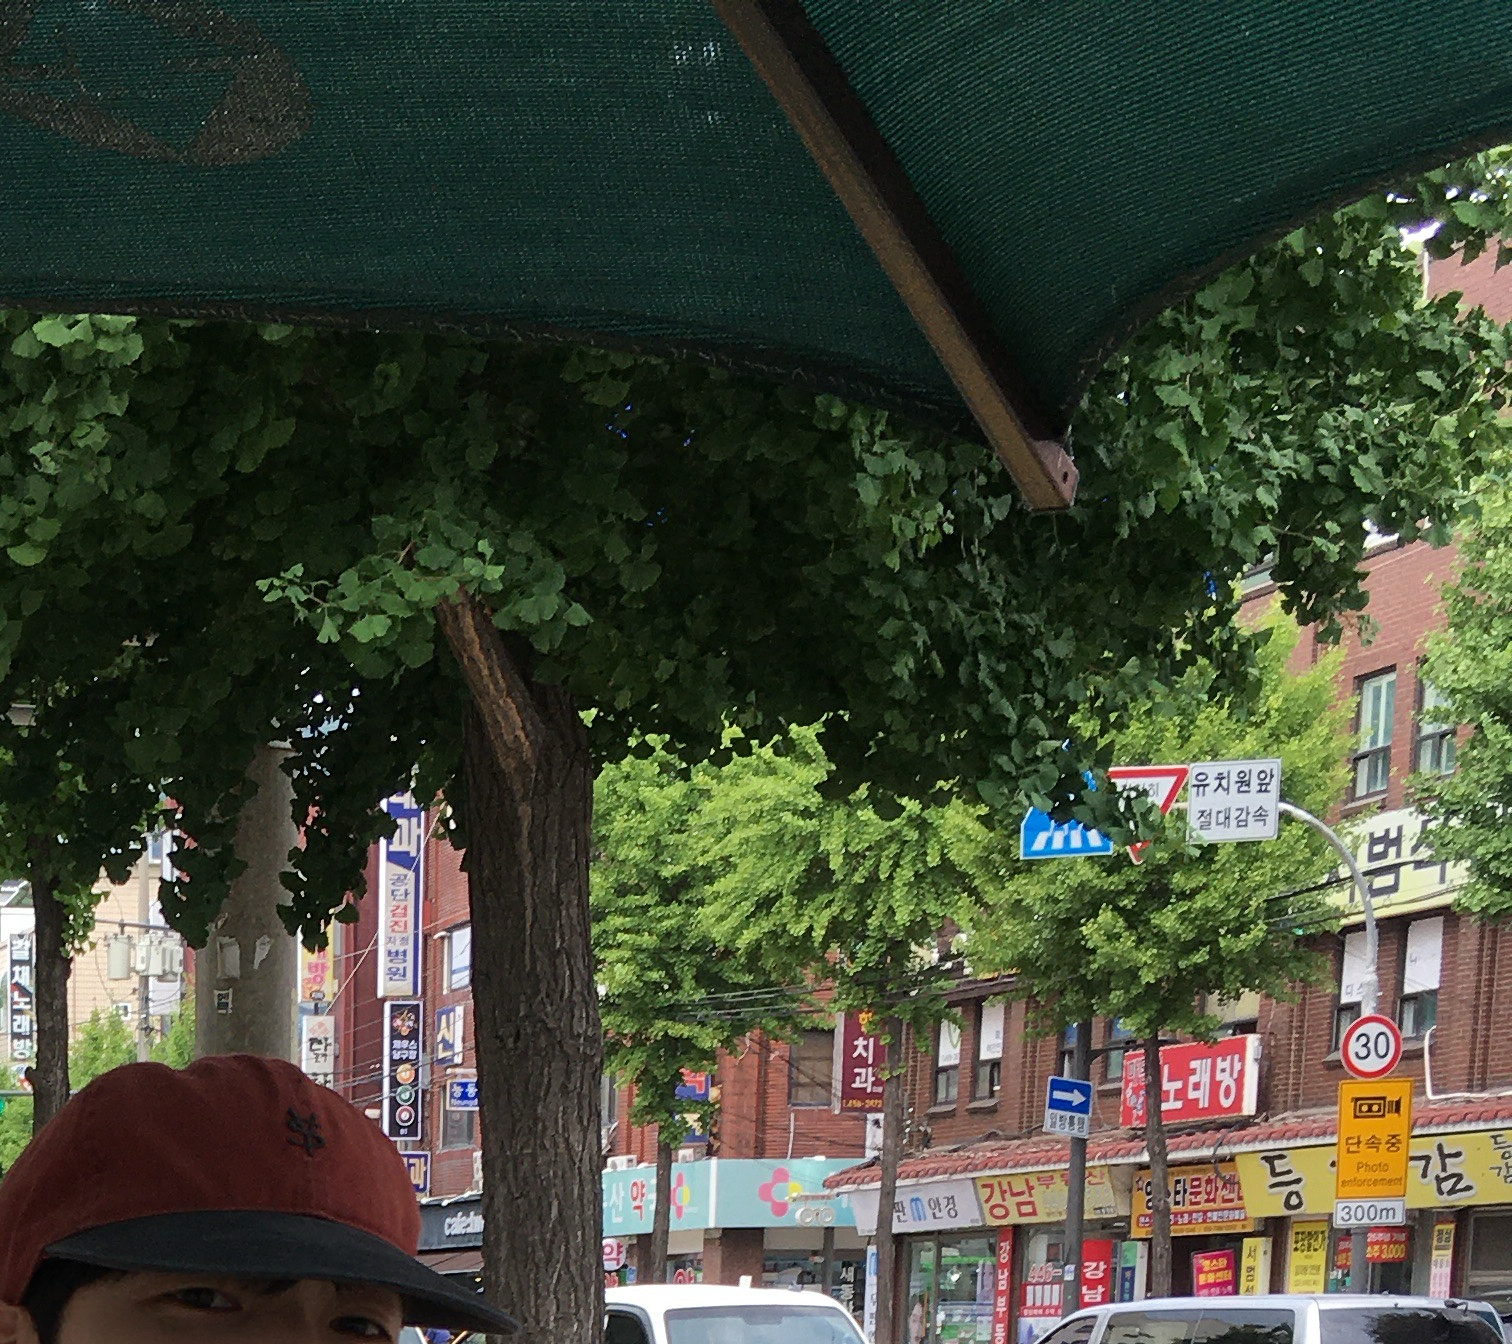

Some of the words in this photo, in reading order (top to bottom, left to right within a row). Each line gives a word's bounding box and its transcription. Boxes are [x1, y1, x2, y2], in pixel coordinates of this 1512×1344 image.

[1191, 767, 1276, 798] 유치원앞
[1196, 805, 1270, 832] 절대감속
[387, 949, 409, 982] 병원
[1354, 1031, 1390, 1061] 30
[851, 1036, 877, 1094] 치과
[1161, 1053, 1243, 1110] 노래방
[1049, 1112, 1086, 1134] 일방통행
[1345, 1133, 1403, 1154] 단속중
[1356, 1161, 1390, 1174] Photo
[1340, 1175, 1403, 1189] enforcement
[927, 1194, 959, 1220] 안경
[980, 1177, 1039, 1221] 강남
[1340, 1205, 1396, 1222] 300m
[602, 1240, 625, 1267] 약
[1081, 1260, 1108, 1303] 강남
